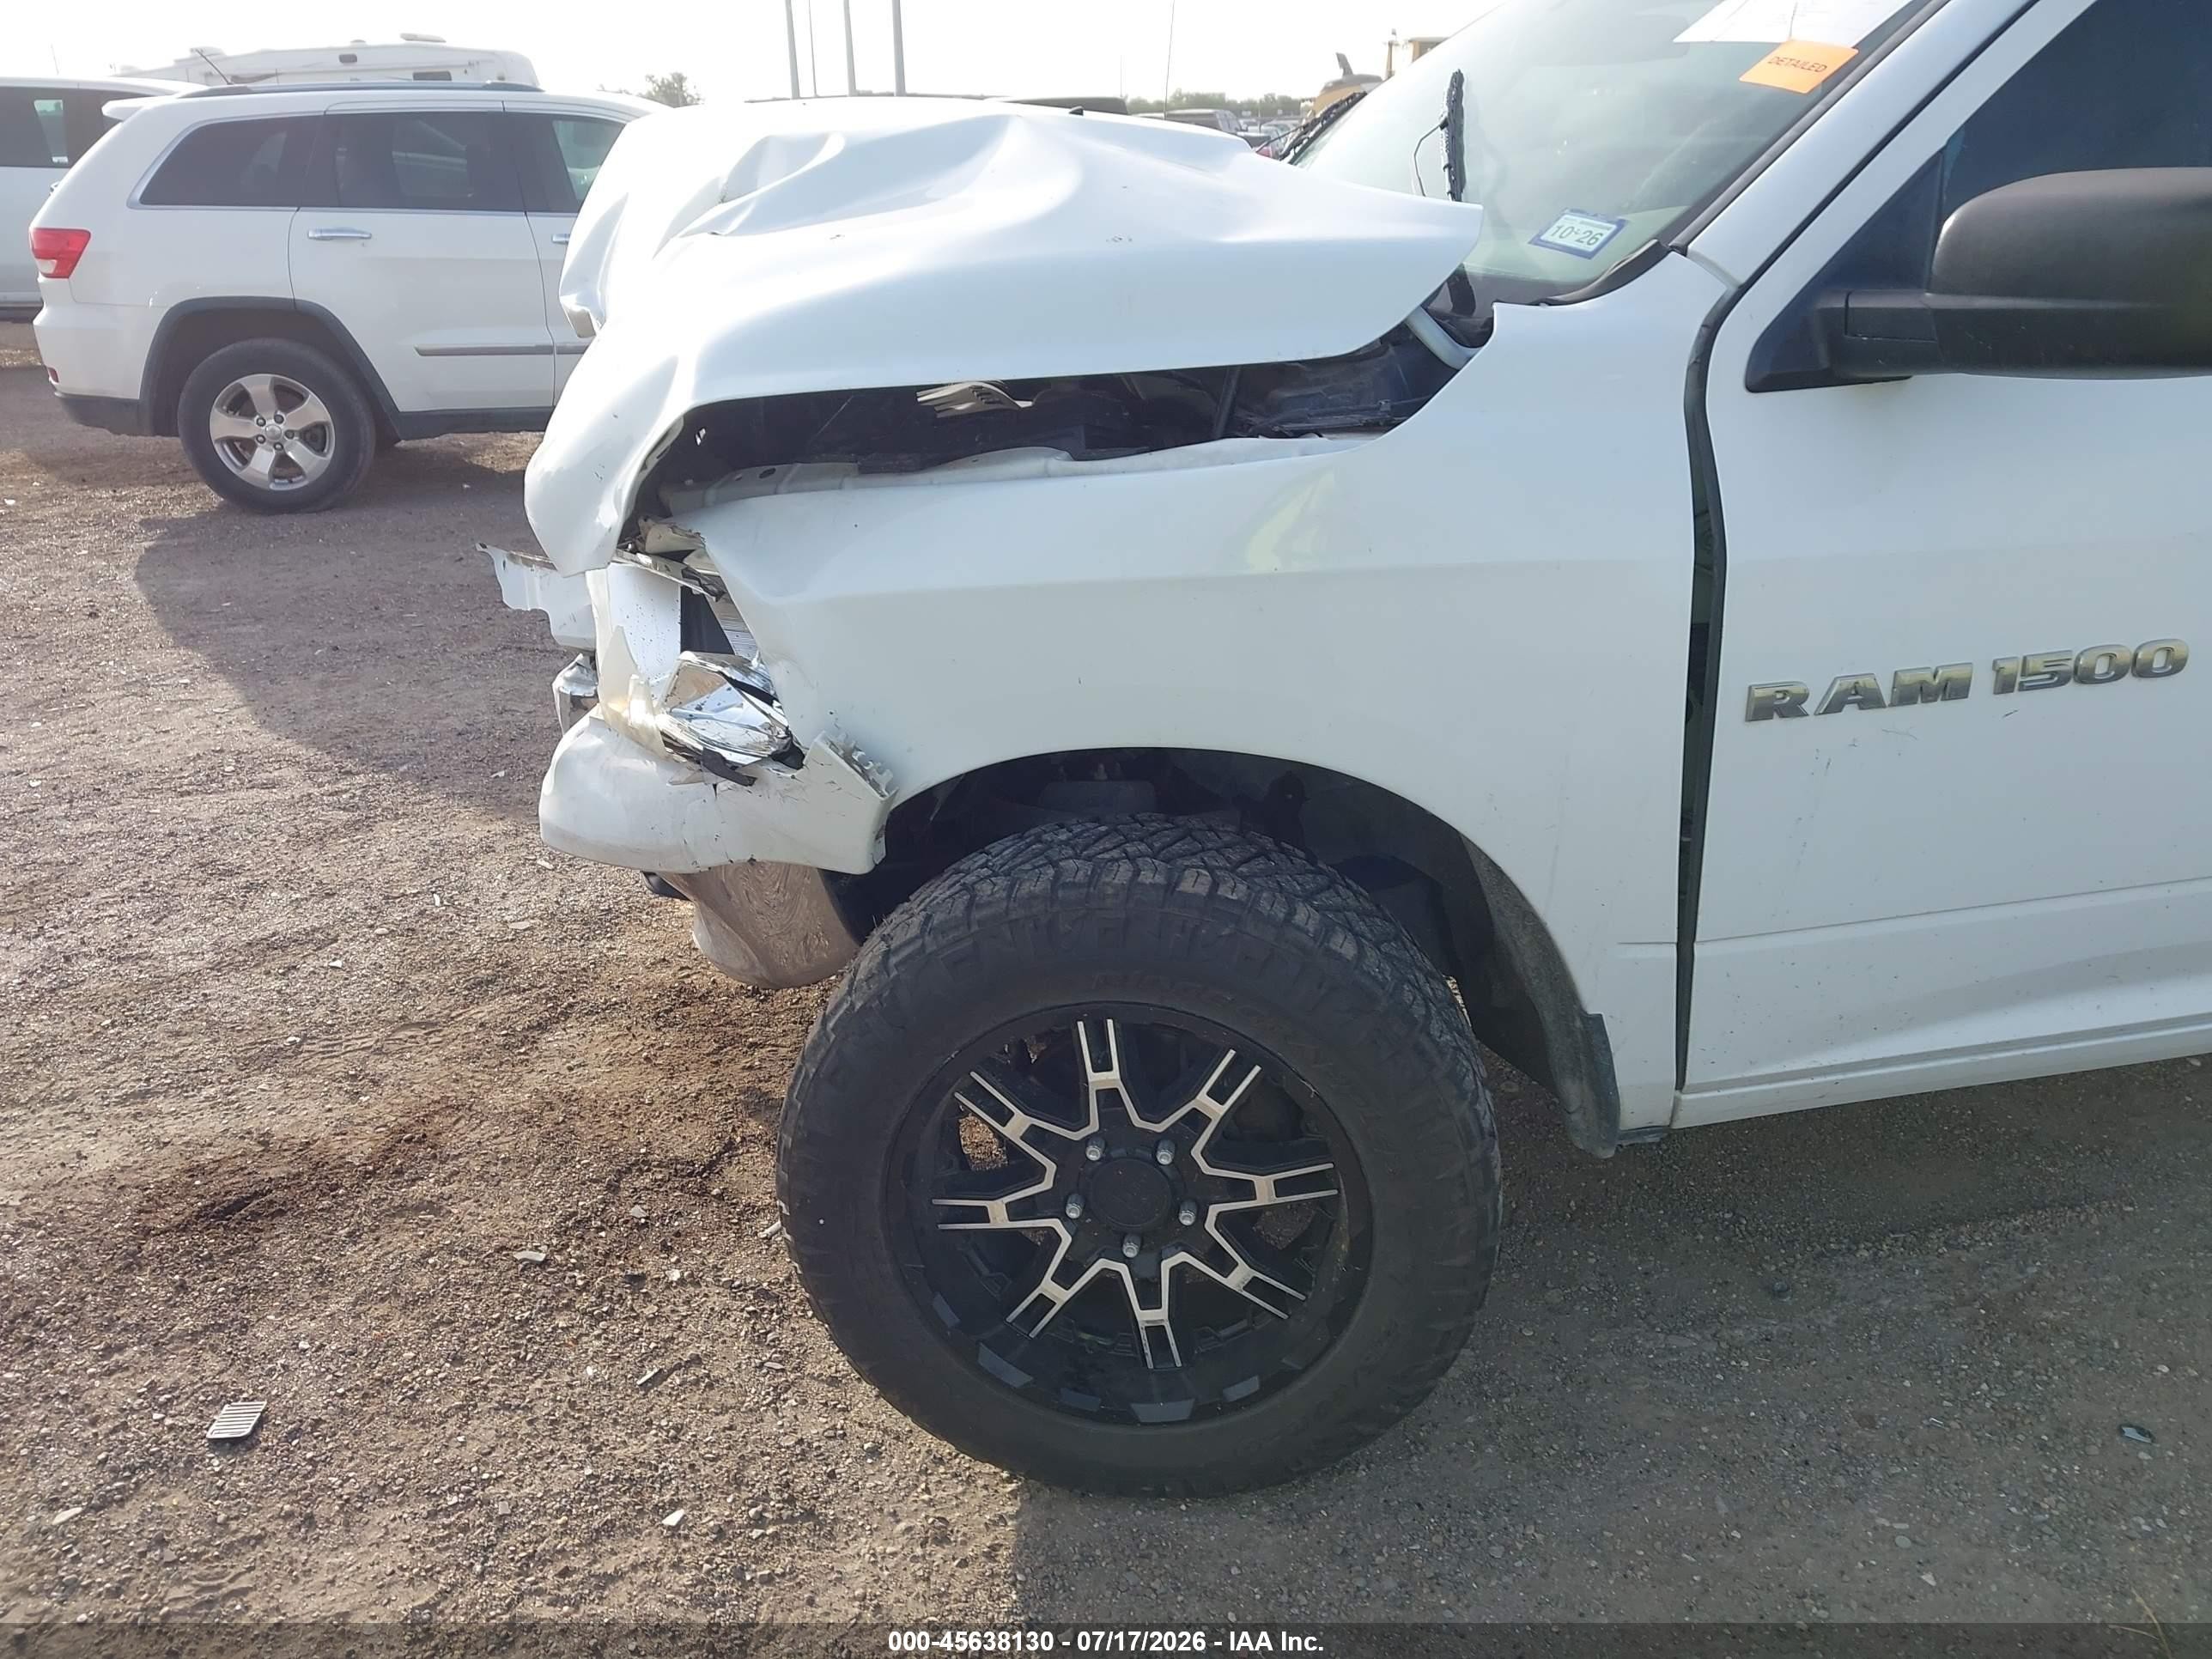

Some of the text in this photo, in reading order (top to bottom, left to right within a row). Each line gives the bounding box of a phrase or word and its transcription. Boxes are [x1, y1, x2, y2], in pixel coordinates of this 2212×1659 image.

[1768, 57, 1827, 73] DETAILED
[1745, 638, 2190, 722] RAM 1500
